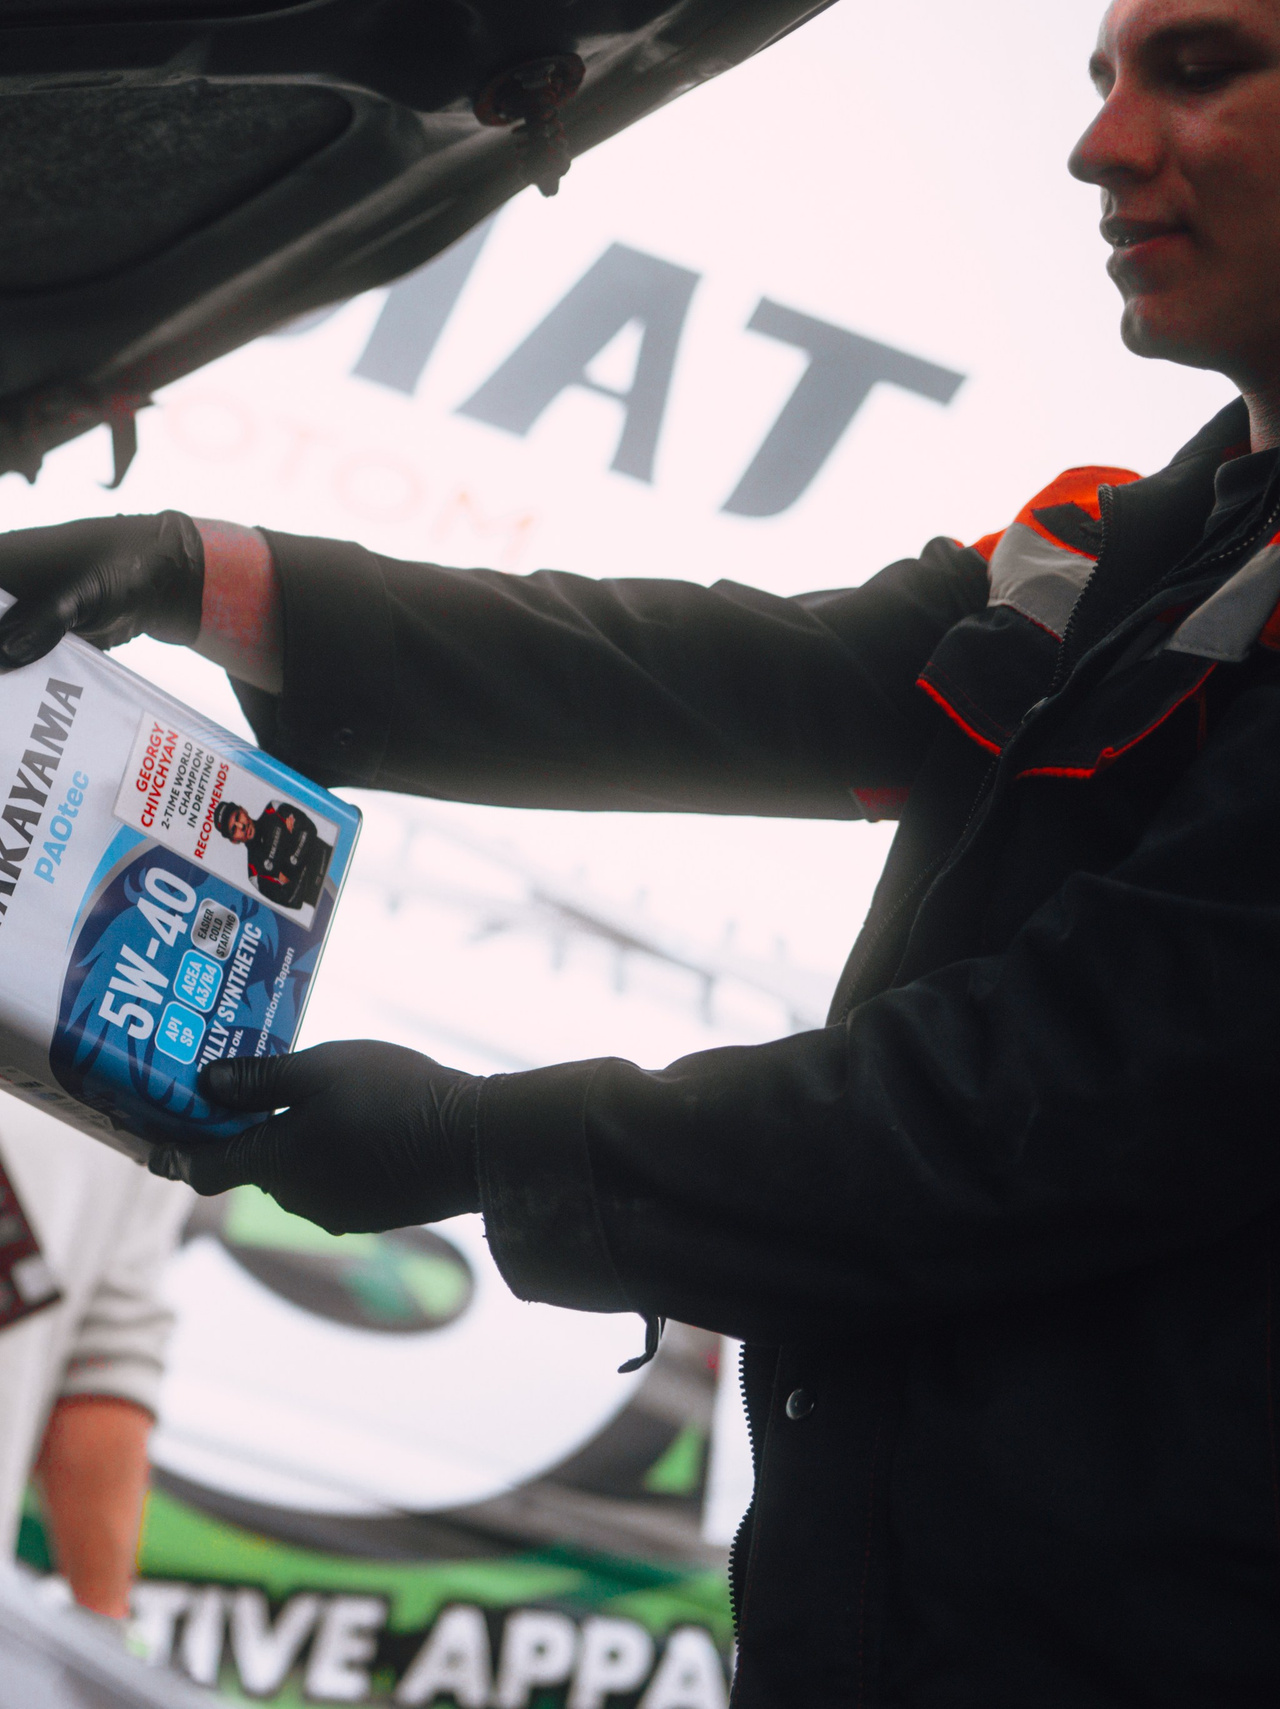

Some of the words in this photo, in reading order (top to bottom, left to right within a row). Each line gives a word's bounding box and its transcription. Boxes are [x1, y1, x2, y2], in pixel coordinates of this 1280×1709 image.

[136, 721, 165, 793] GEORGY
[140, 730, 179, 828] CHIVCHYAN
[161, 787, 181, 830] 2-TIME
[174, 741, 193, 789] WORLD
[178, 748, 204, 816] CHAMPION
[187, 811, 198, 829] IN
[193, 754, 215, 813] DRIFTING
[33, 770, 89, 885] PAOtec
[194, 763, 230, 860] RECOMMENDS
[98, 867, 197, 1040] 5W-40
[197, 908, 214, 940] EASIER
[209, 918, 223, 942] COLD
[216, 914, 236, 959] STARTING
[181, 960, 202, 996] ACEA
[195, 964, 217, 1007] A3/B4
[217, 922, 262, 1022] SYNTHETIC
[254, 992, 283, 1057] rporation,
[274, 946, 295, 989] Japan
[165, 1016, 183, 1043] API
[180, 1027, 195, 1047] SP
[232, 1030, 244, 1047] OIL
[132, 1584, 387, 1698] TIVE
[397, 1601, 728, 1709] APPA
